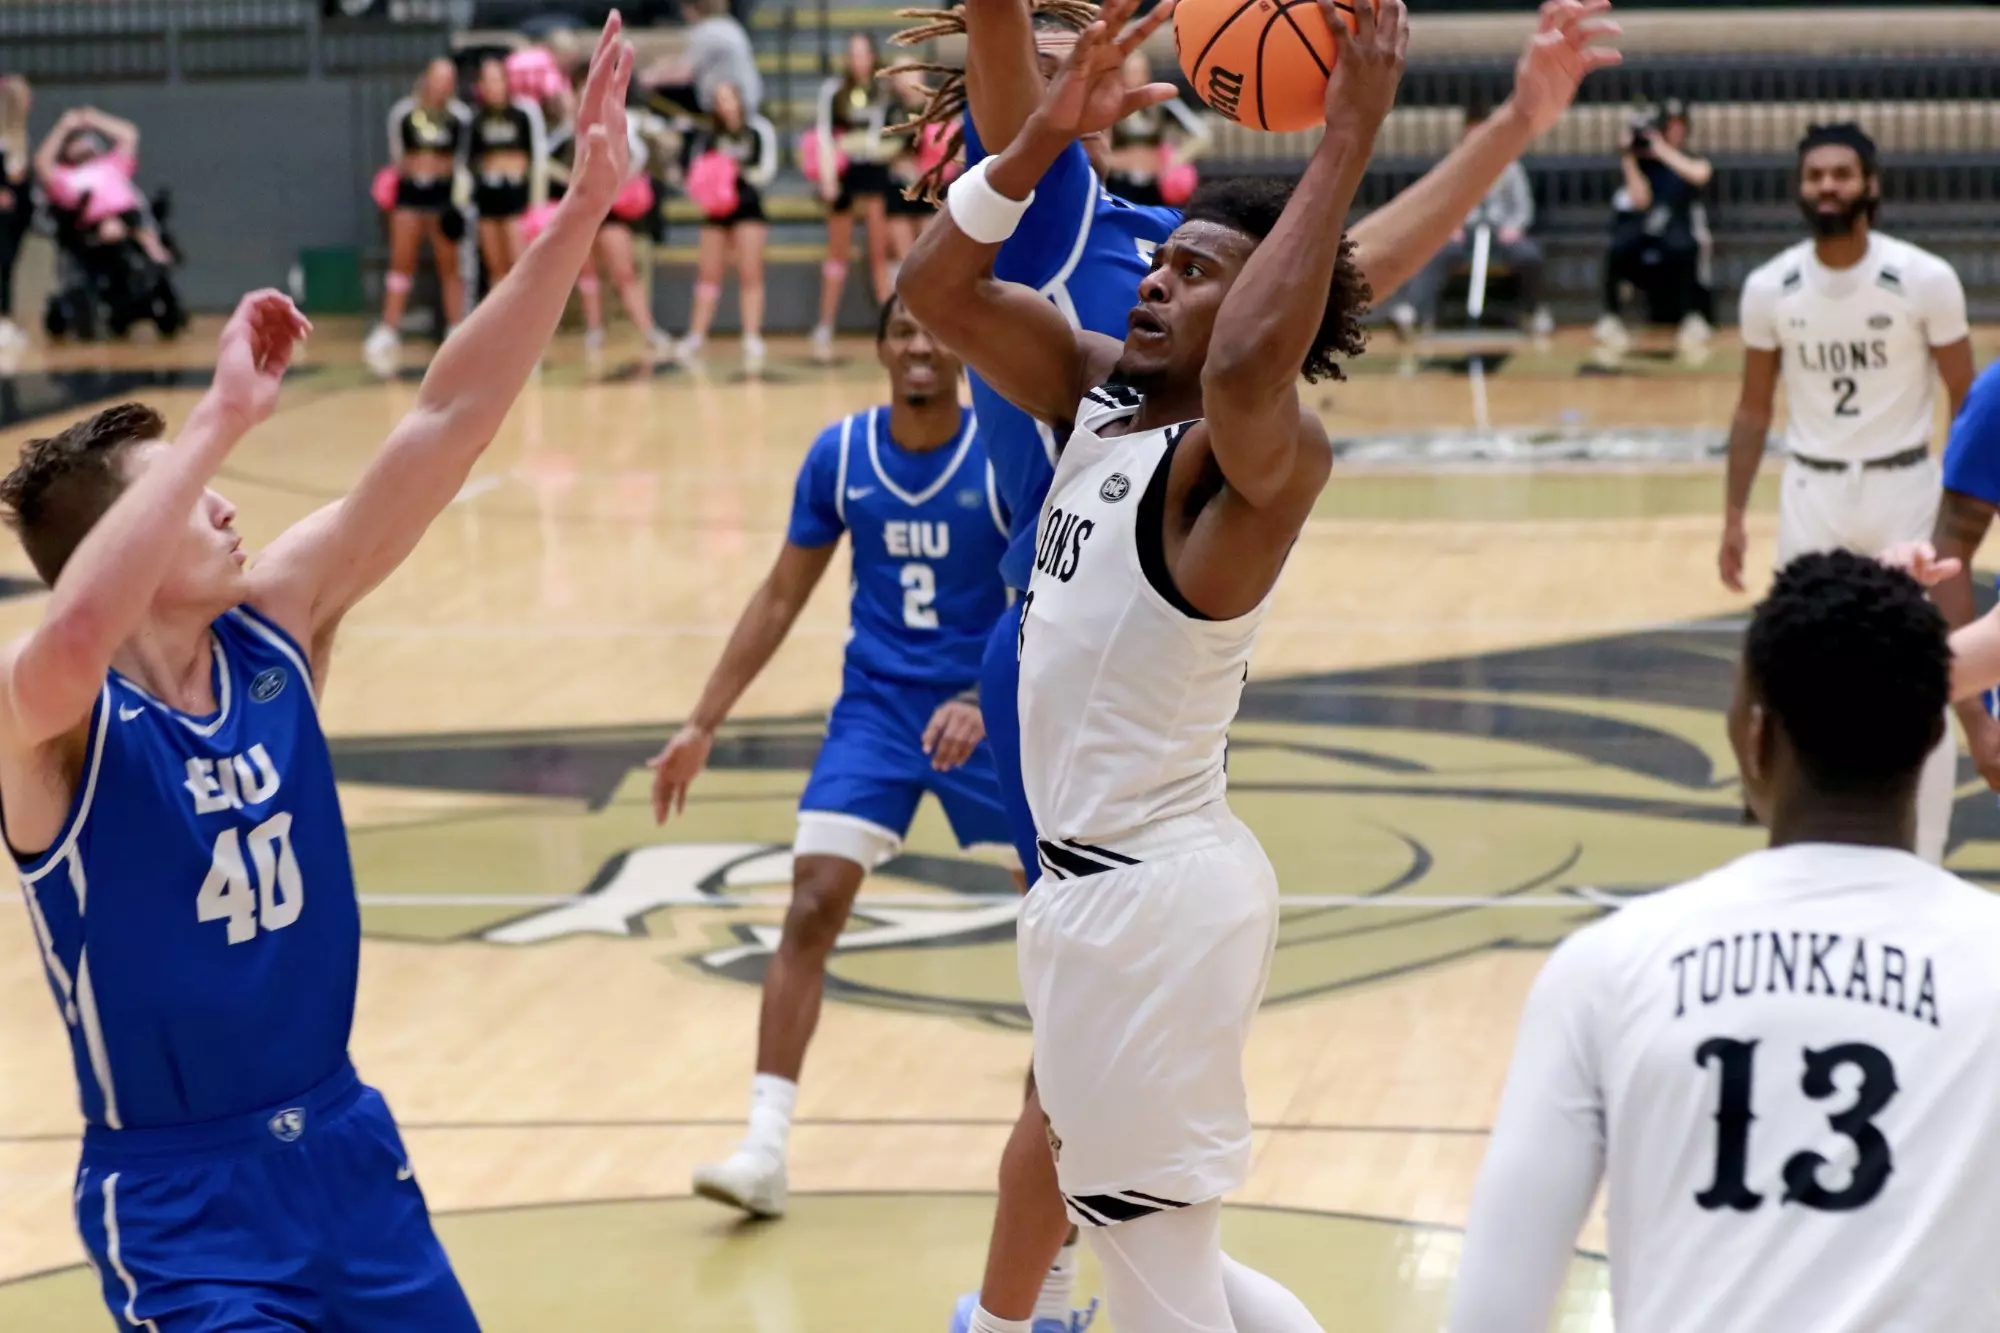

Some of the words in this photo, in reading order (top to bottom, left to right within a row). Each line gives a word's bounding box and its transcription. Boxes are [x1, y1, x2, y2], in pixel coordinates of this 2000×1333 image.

[1799, 340, 1888, 372] LIONS
[1832, 377, 1860, 417] 2
[883, 520, 950, 558] EIU
[1037, 506, 1096, 583] ONS
[900, 562, 940, 630] 2
[184, 743, 280, 815] EIU
[196, 811, 304, 945] 40
[1671, 931, 1940, 1028] TOUNKARA
[1694, 1037, 1901, 1212] 13
